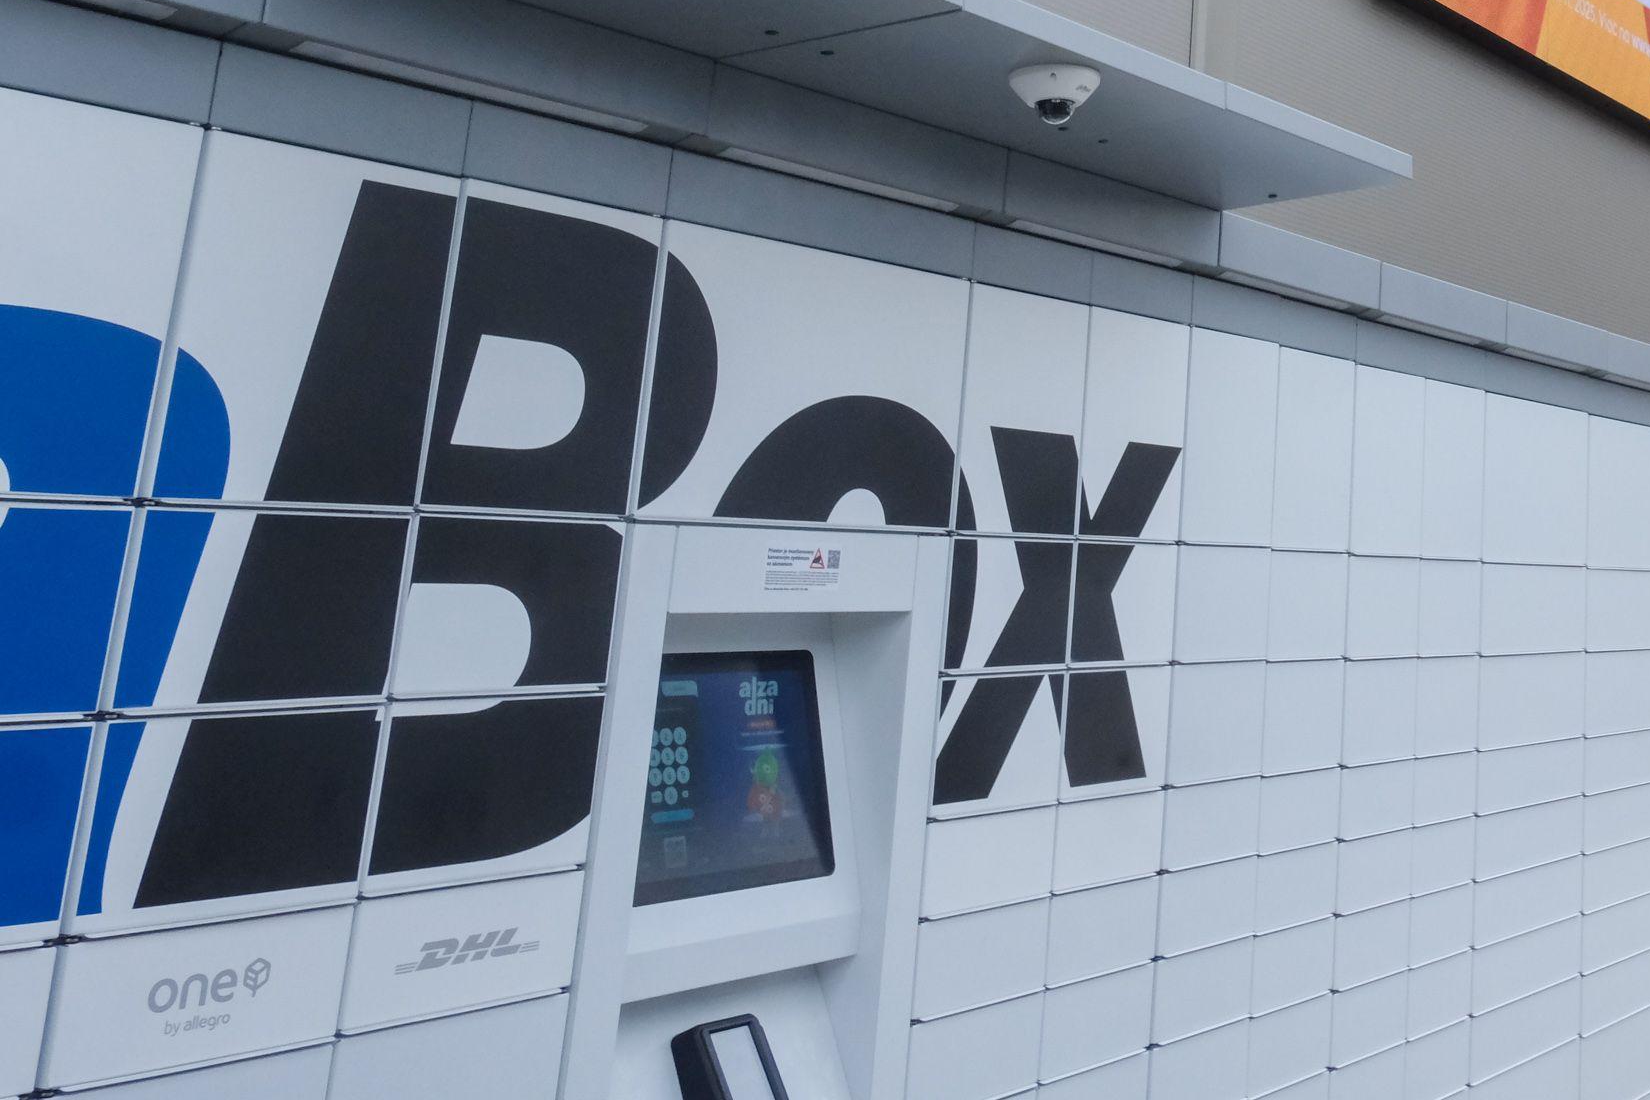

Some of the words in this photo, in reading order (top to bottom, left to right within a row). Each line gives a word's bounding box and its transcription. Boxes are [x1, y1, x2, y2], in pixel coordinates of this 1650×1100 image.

[738, 676, 779, 699] alza
[415, 927, 522, 973] DHL
[147, 968, 238, 1014] one
[164, 1019, 181, 1037] by
[183, 1013, 231, 1033] allegro
